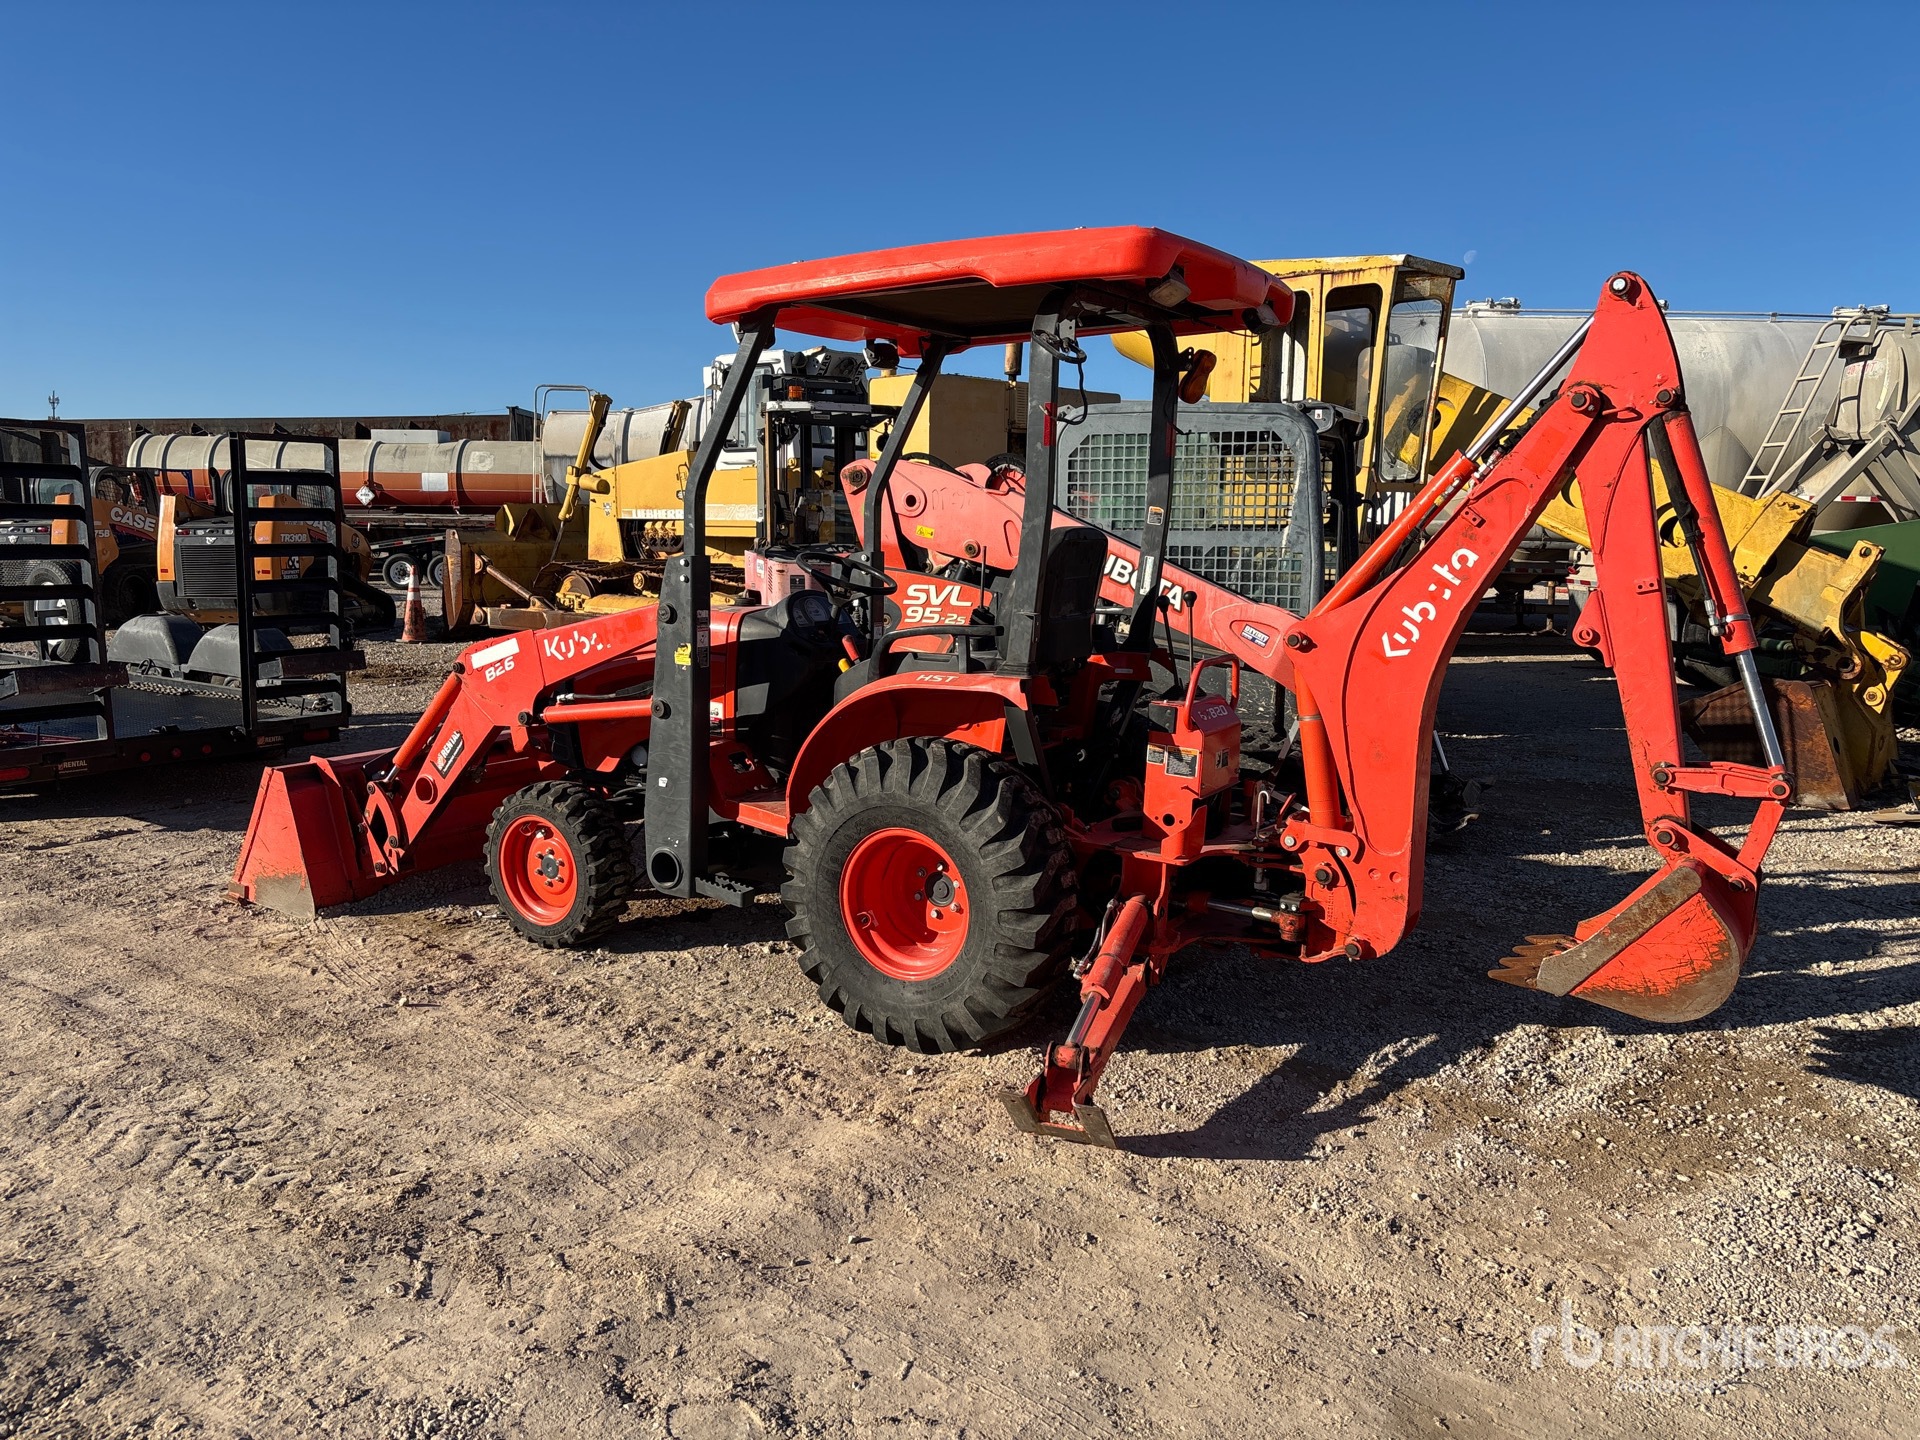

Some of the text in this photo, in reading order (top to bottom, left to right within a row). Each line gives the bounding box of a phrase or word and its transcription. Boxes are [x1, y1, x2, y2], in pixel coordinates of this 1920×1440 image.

[110, 506, 156, 532] CASE
[902, 584, 973, 607] SVL
[485, 656, 515, 682] B26
[916, 674, 959, 682] HST
[440, 731, 461, 758] RENTAL
[63, 760, 88, 768] RENTAL
